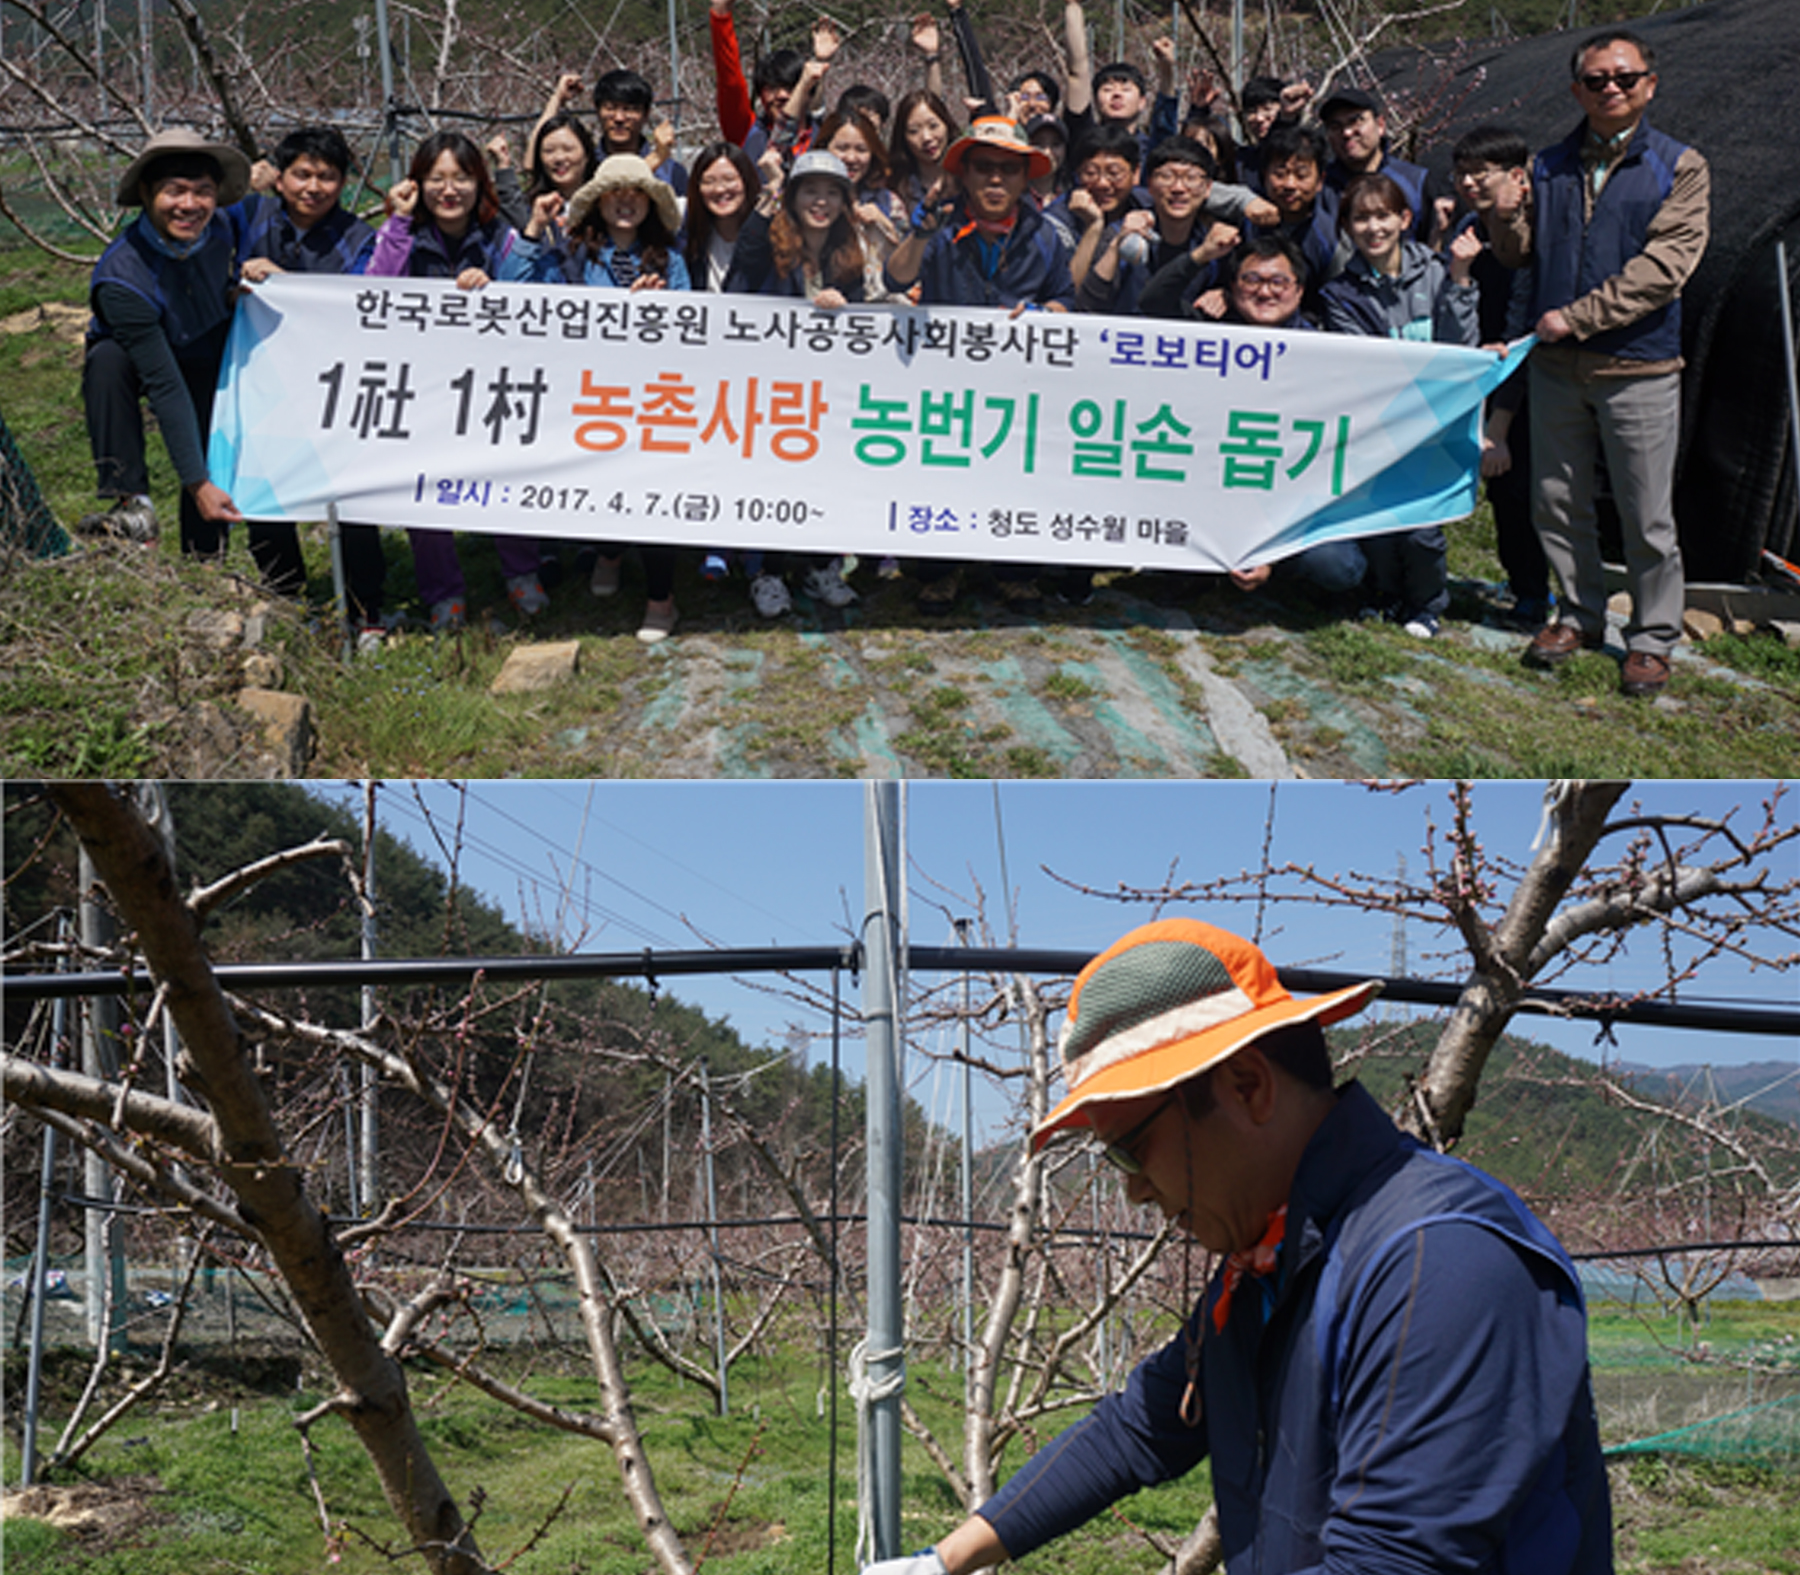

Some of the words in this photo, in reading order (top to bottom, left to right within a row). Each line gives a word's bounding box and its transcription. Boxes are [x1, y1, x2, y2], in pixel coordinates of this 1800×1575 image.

[356, 288, 709, 347] 한국로봇산업진흥원
[722, 310, 1079, 368] 노사공동사회봉사단
[317, 359, 416, 440] 1社
[450, 365, 548, 446] 1村
[571, 368, 830, 462] 농촌사랑
[851, 382, 1040, 474] 농번기
[1068, 396, 1194, 482] 일손
[1219, 408, 1351, 496] 돕기
[435, 477, 493, 507] 일시
[520, 484, 597, 513] 2017.
[608, 490, 636, 515] 4.
[907, 504, 961, 535] 장소
[987, 508, 1039, 539] 청도
[1050, 512, 1127, 542] 성수월
[1137, 515, 1191, 546] 마을
